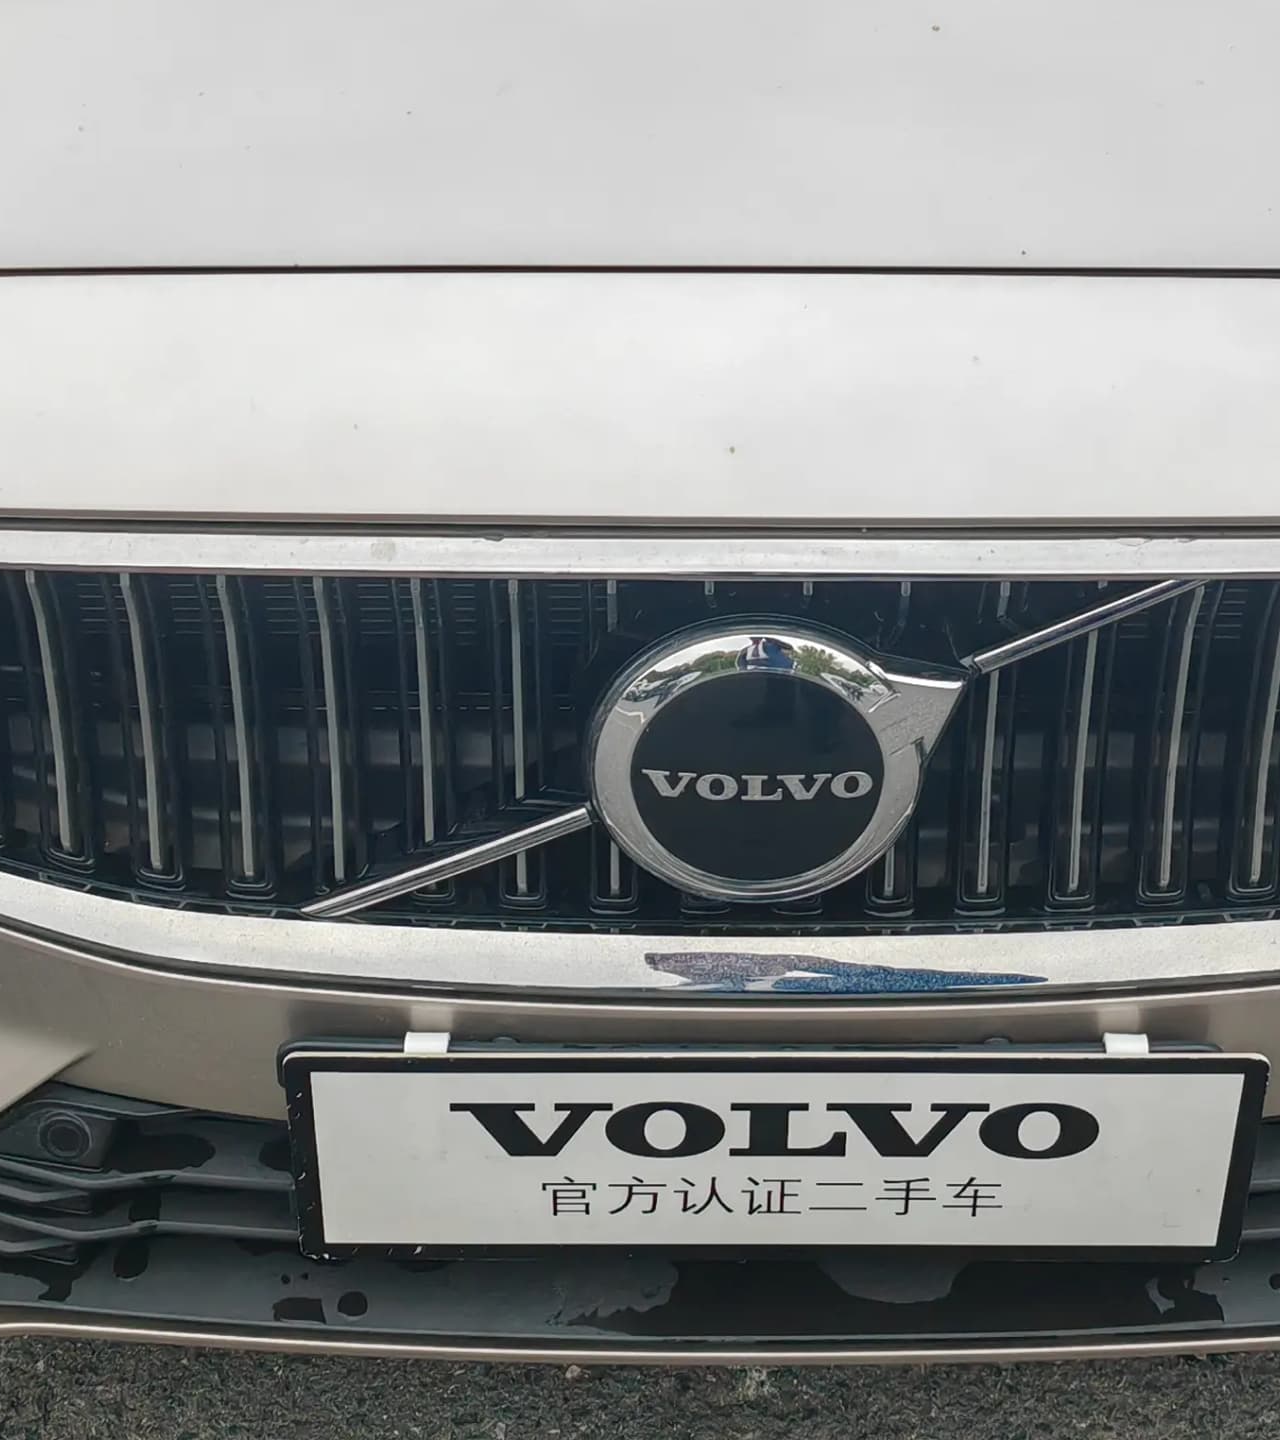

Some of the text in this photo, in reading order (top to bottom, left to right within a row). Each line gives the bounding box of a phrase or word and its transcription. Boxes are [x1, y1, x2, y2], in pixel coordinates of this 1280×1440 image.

[641, 768, 873, 801] VOLVO
[449, 1101, 1100, 1160] VOLVO
[540, 1176, 1004, 1218] 官方认证二手车
